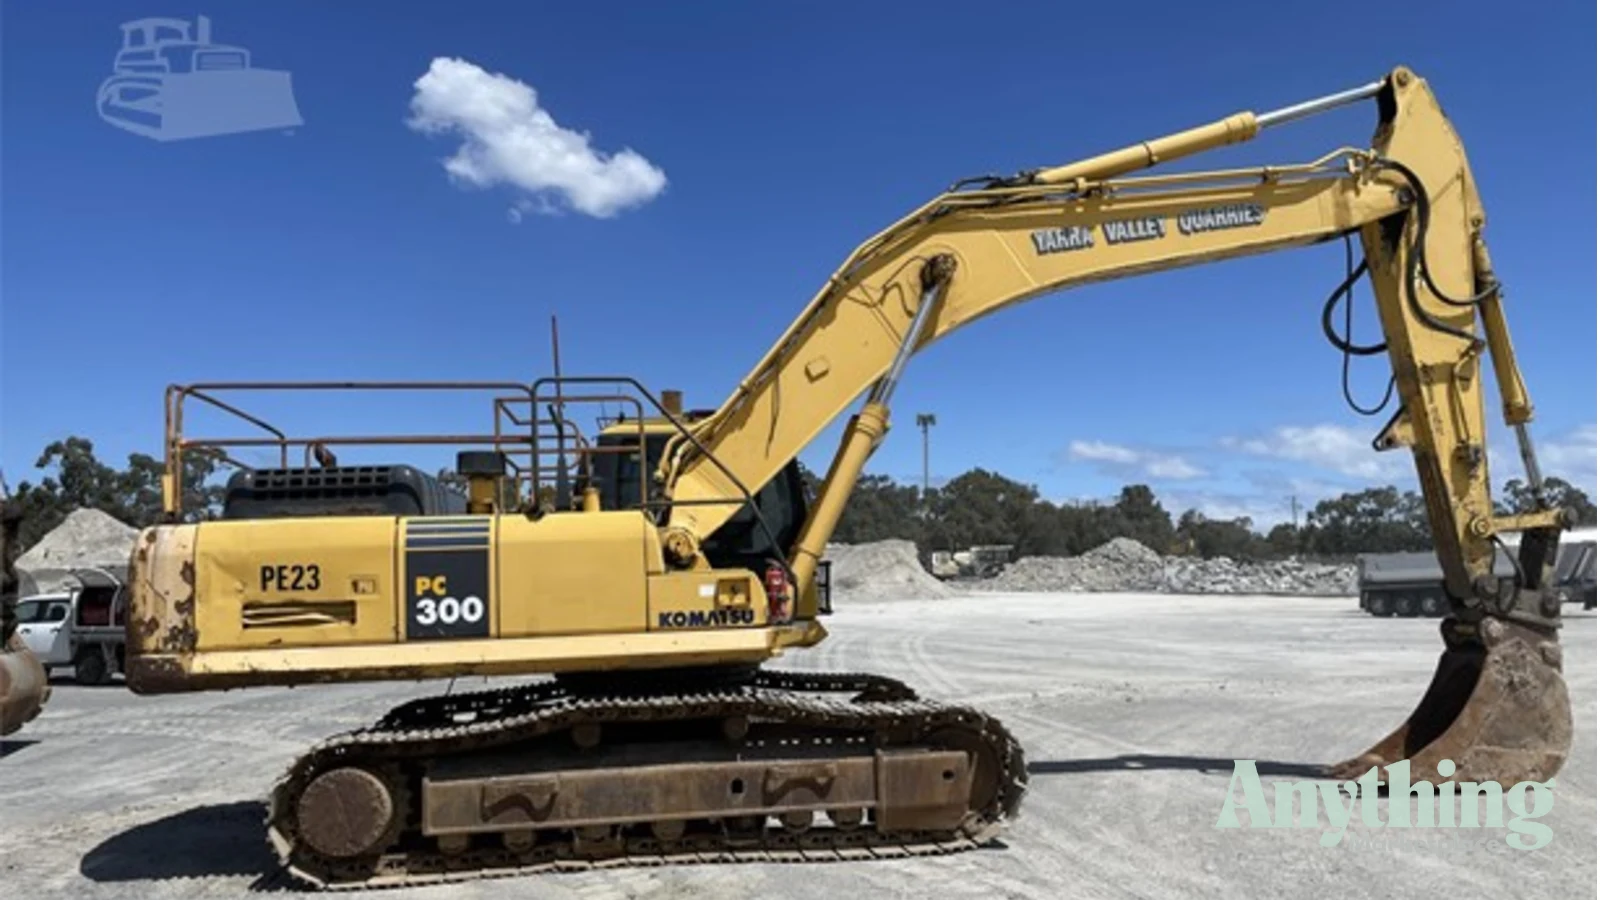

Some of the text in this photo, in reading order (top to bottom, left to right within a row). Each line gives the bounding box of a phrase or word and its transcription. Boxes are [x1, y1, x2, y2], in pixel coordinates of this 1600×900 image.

[1032, 204, 1267, 255] YARRA VALLEY QUARRIES
[261, 565, 320, 591] PE23
[415, 576, 446, 595] PC
[416, 597, 484, 625] 300
[659, 610, 754, 627] KOMATSU
